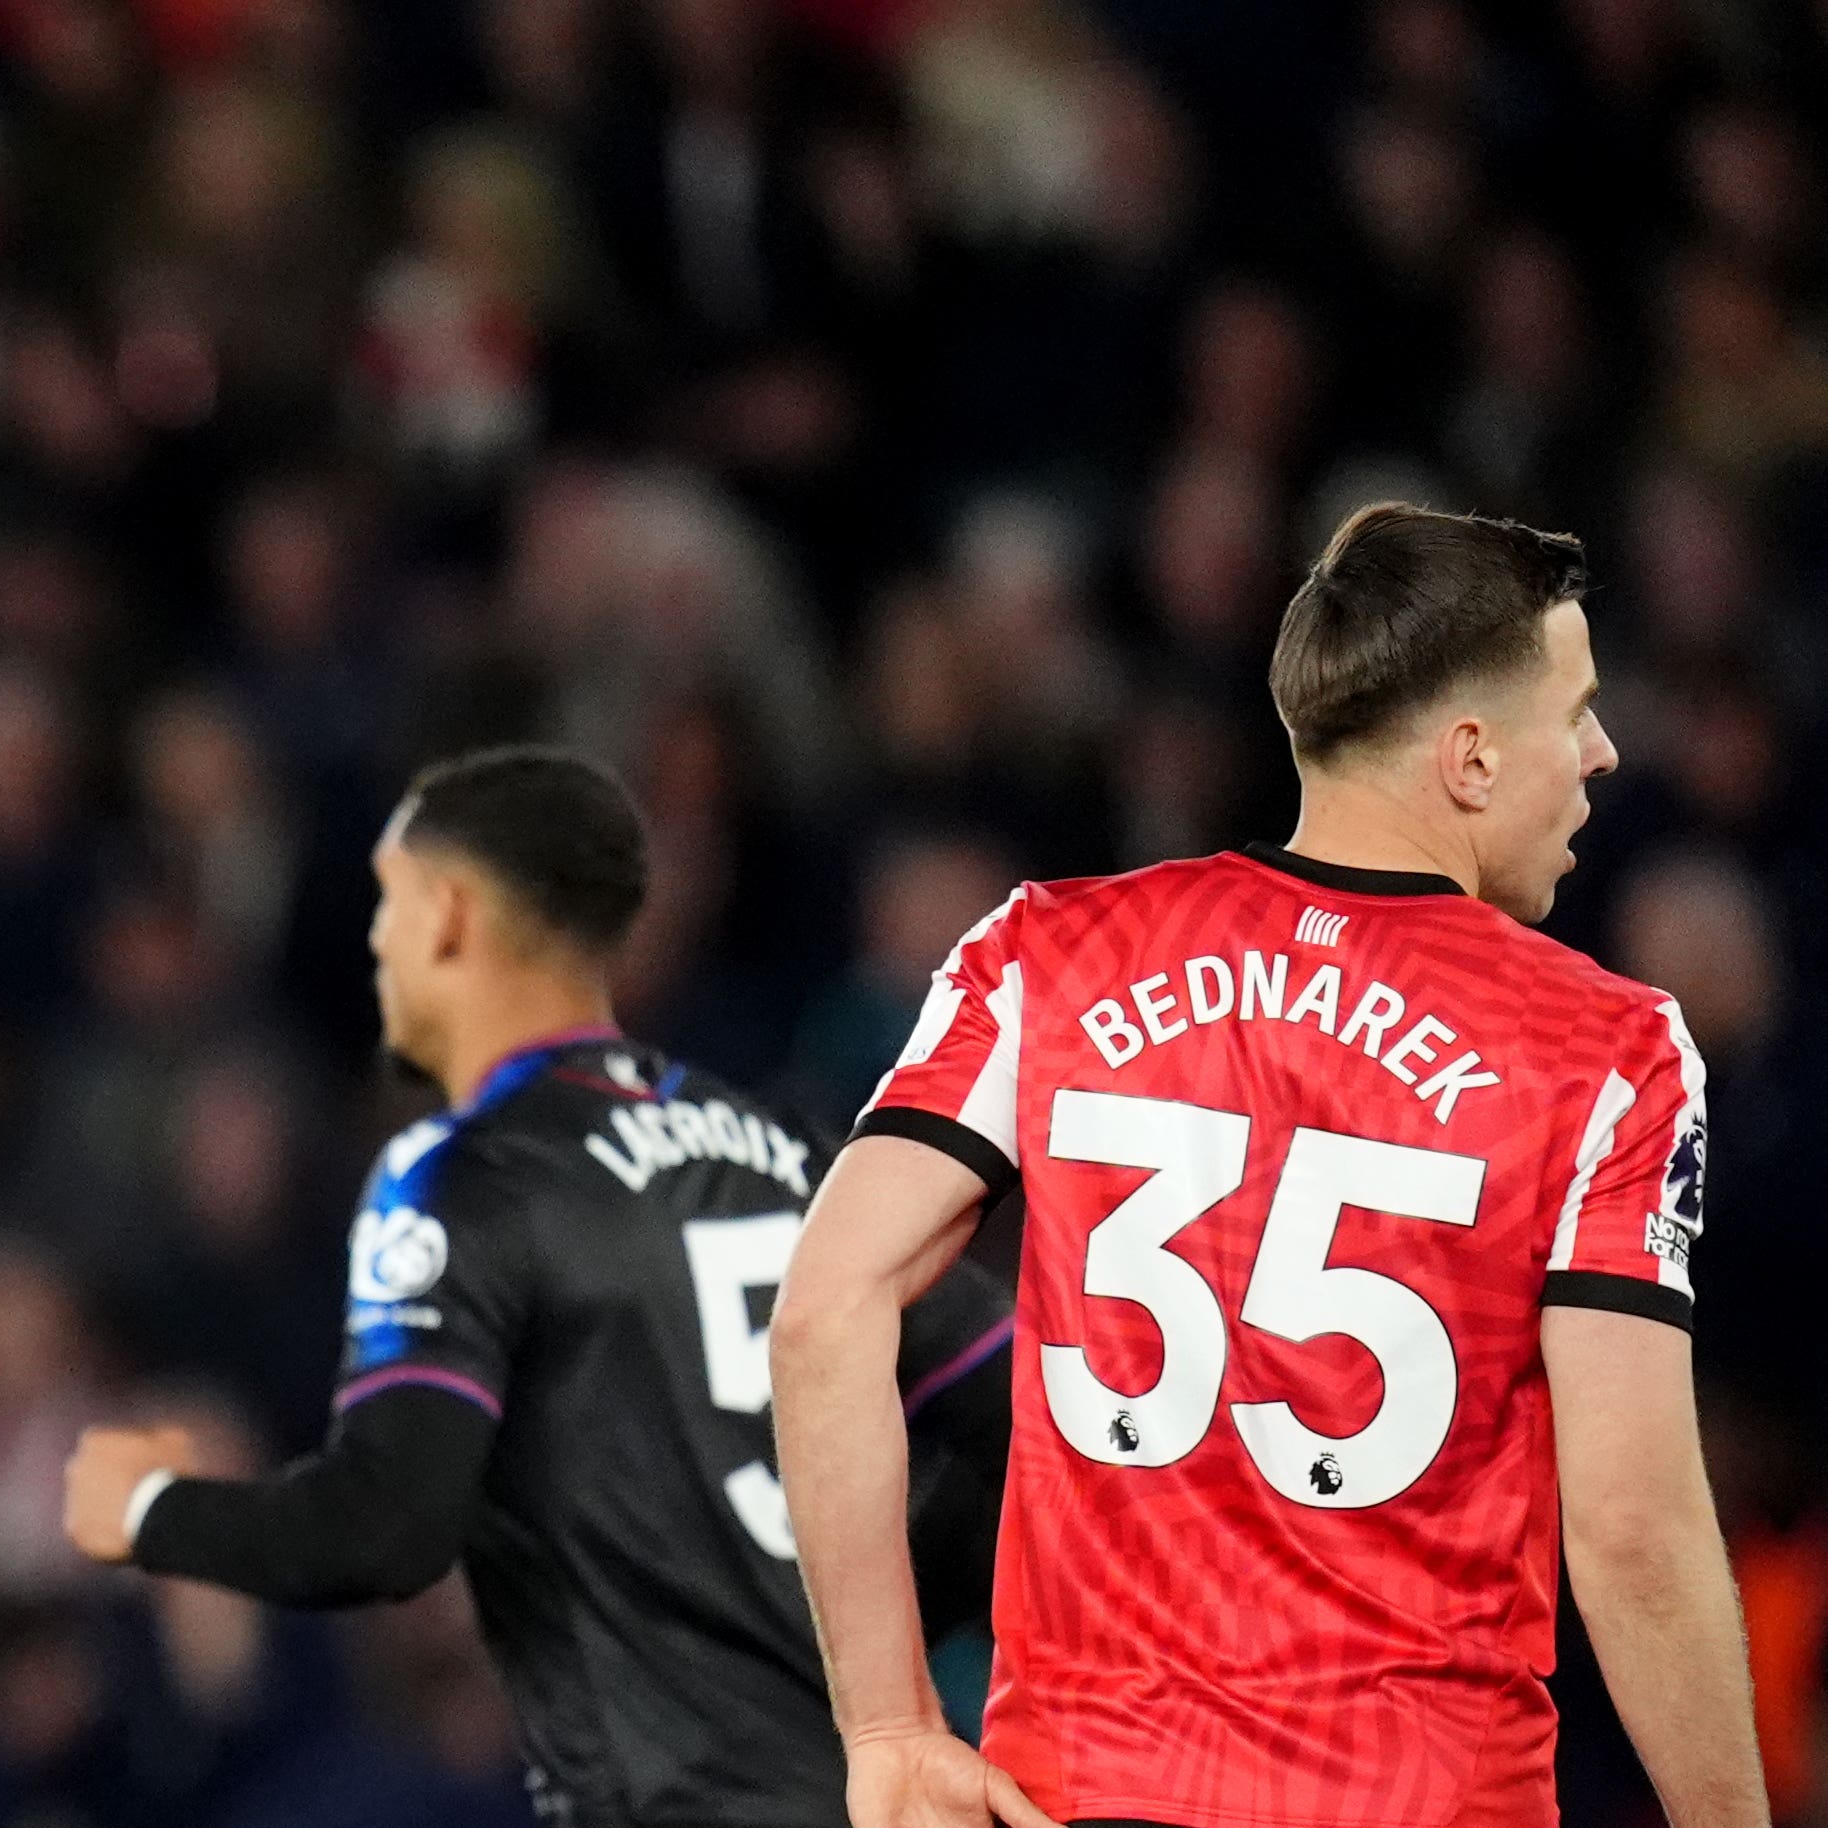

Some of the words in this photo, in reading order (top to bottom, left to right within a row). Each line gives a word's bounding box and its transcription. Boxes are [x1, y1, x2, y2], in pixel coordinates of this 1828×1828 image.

[1079, 951, 1502, 1125] BEDNAREK
[585, 1099, 811, 1197] LACROIX
[1645, 1212, 1675, 1241] No
[1040, 1088, 1488, 1509] 35
[683, 1212, 802, 1560] 5
